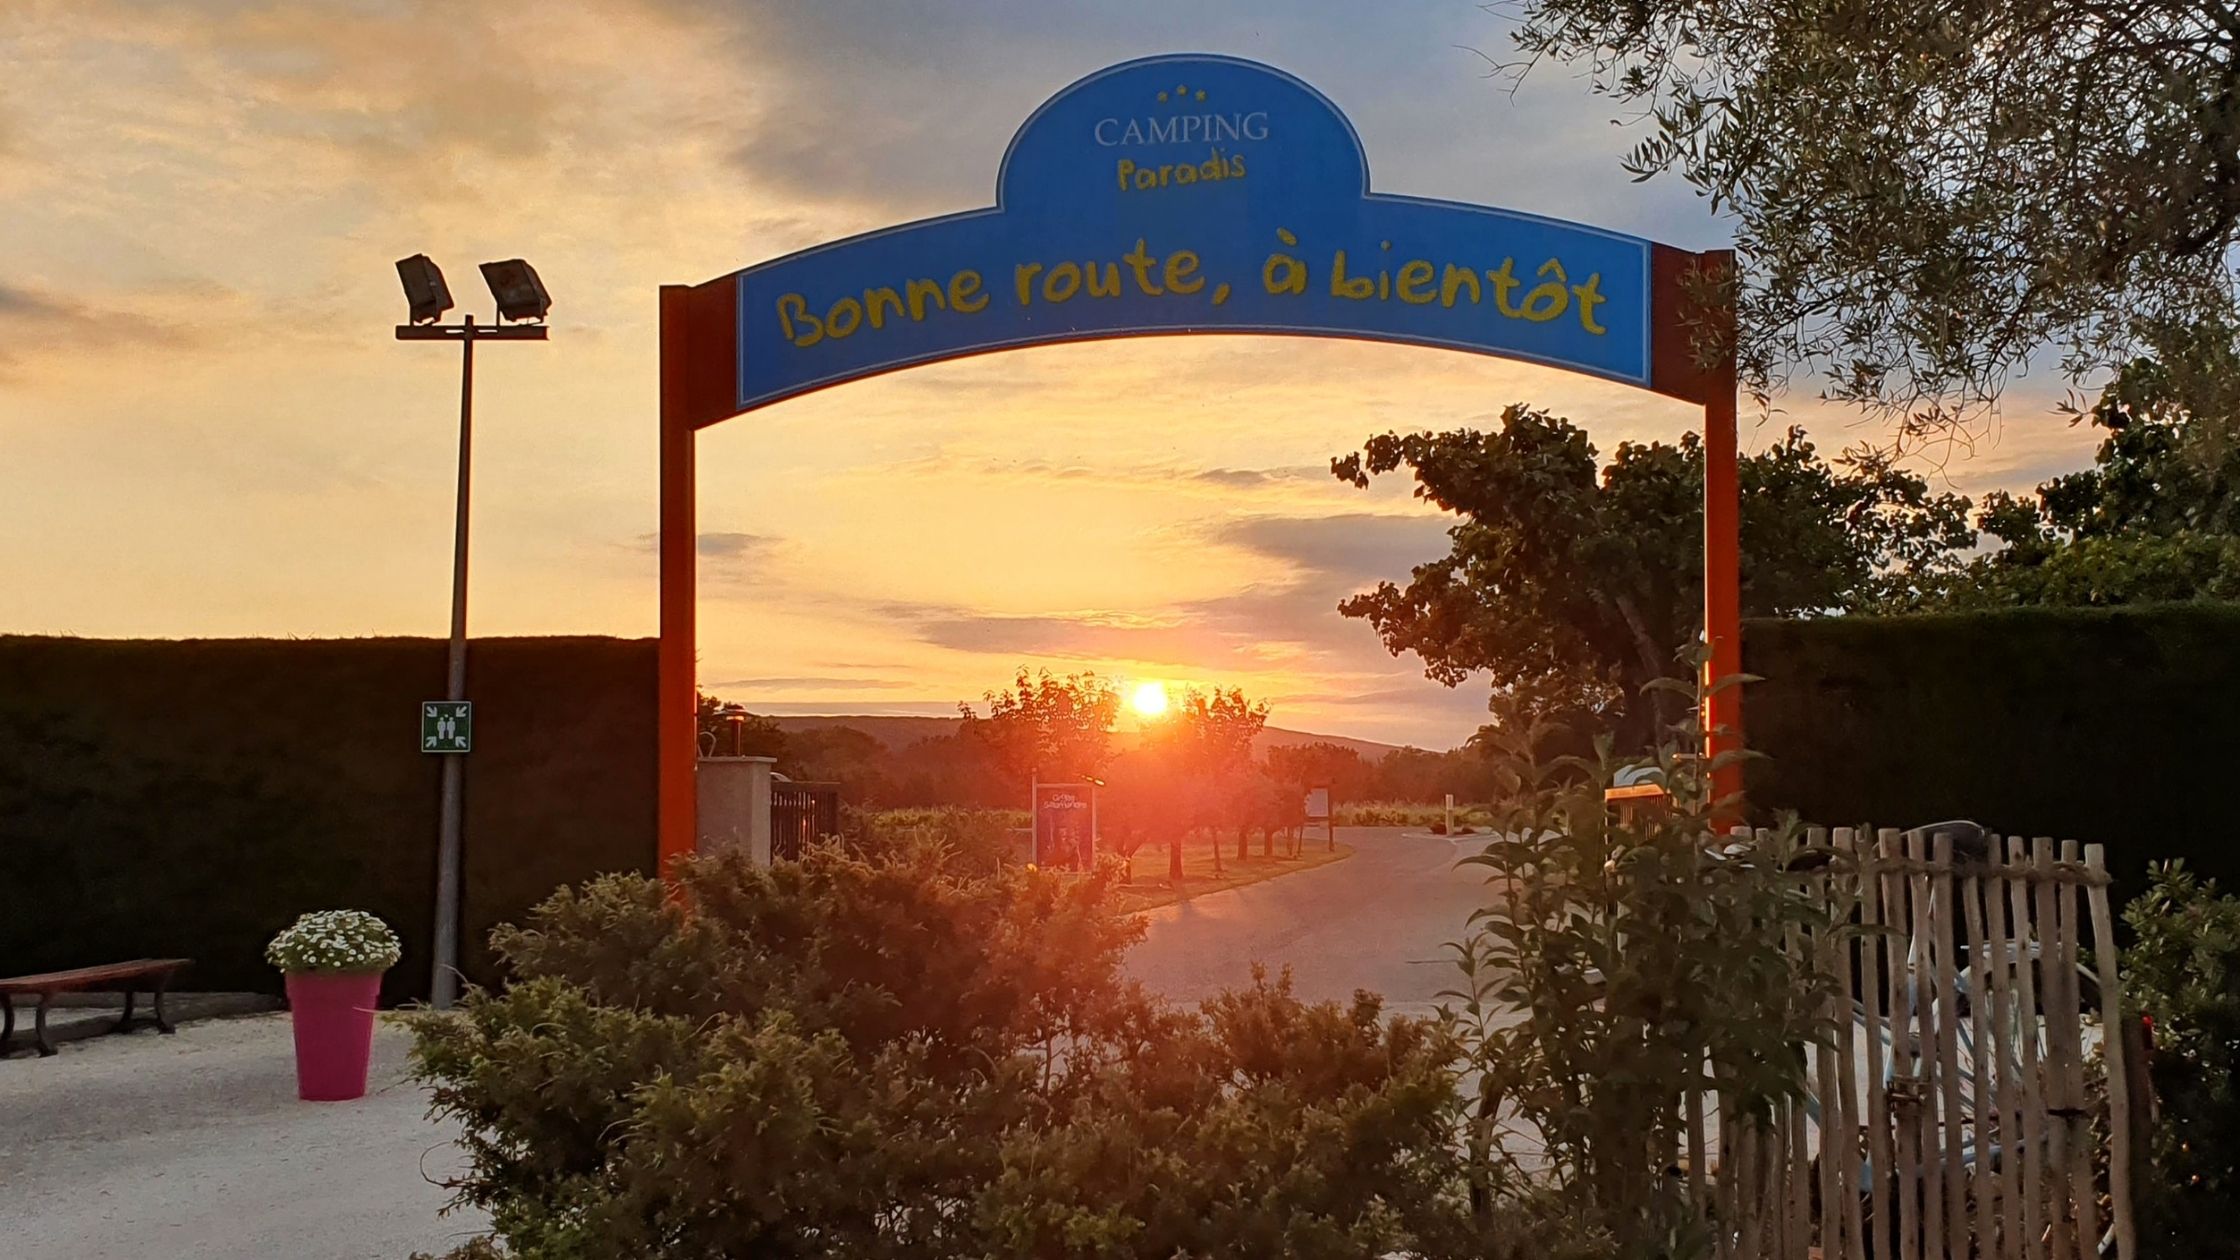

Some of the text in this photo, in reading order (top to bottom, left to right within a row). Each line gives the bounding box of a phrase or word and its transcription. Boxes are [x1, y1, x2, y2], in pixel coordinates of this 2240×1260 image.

[1094, 112, 1269, 147] CAMPING
[1117, 146, 1247, 192] Paradis
[776, 227, 1607, 347] Bonne route, à bientôt
